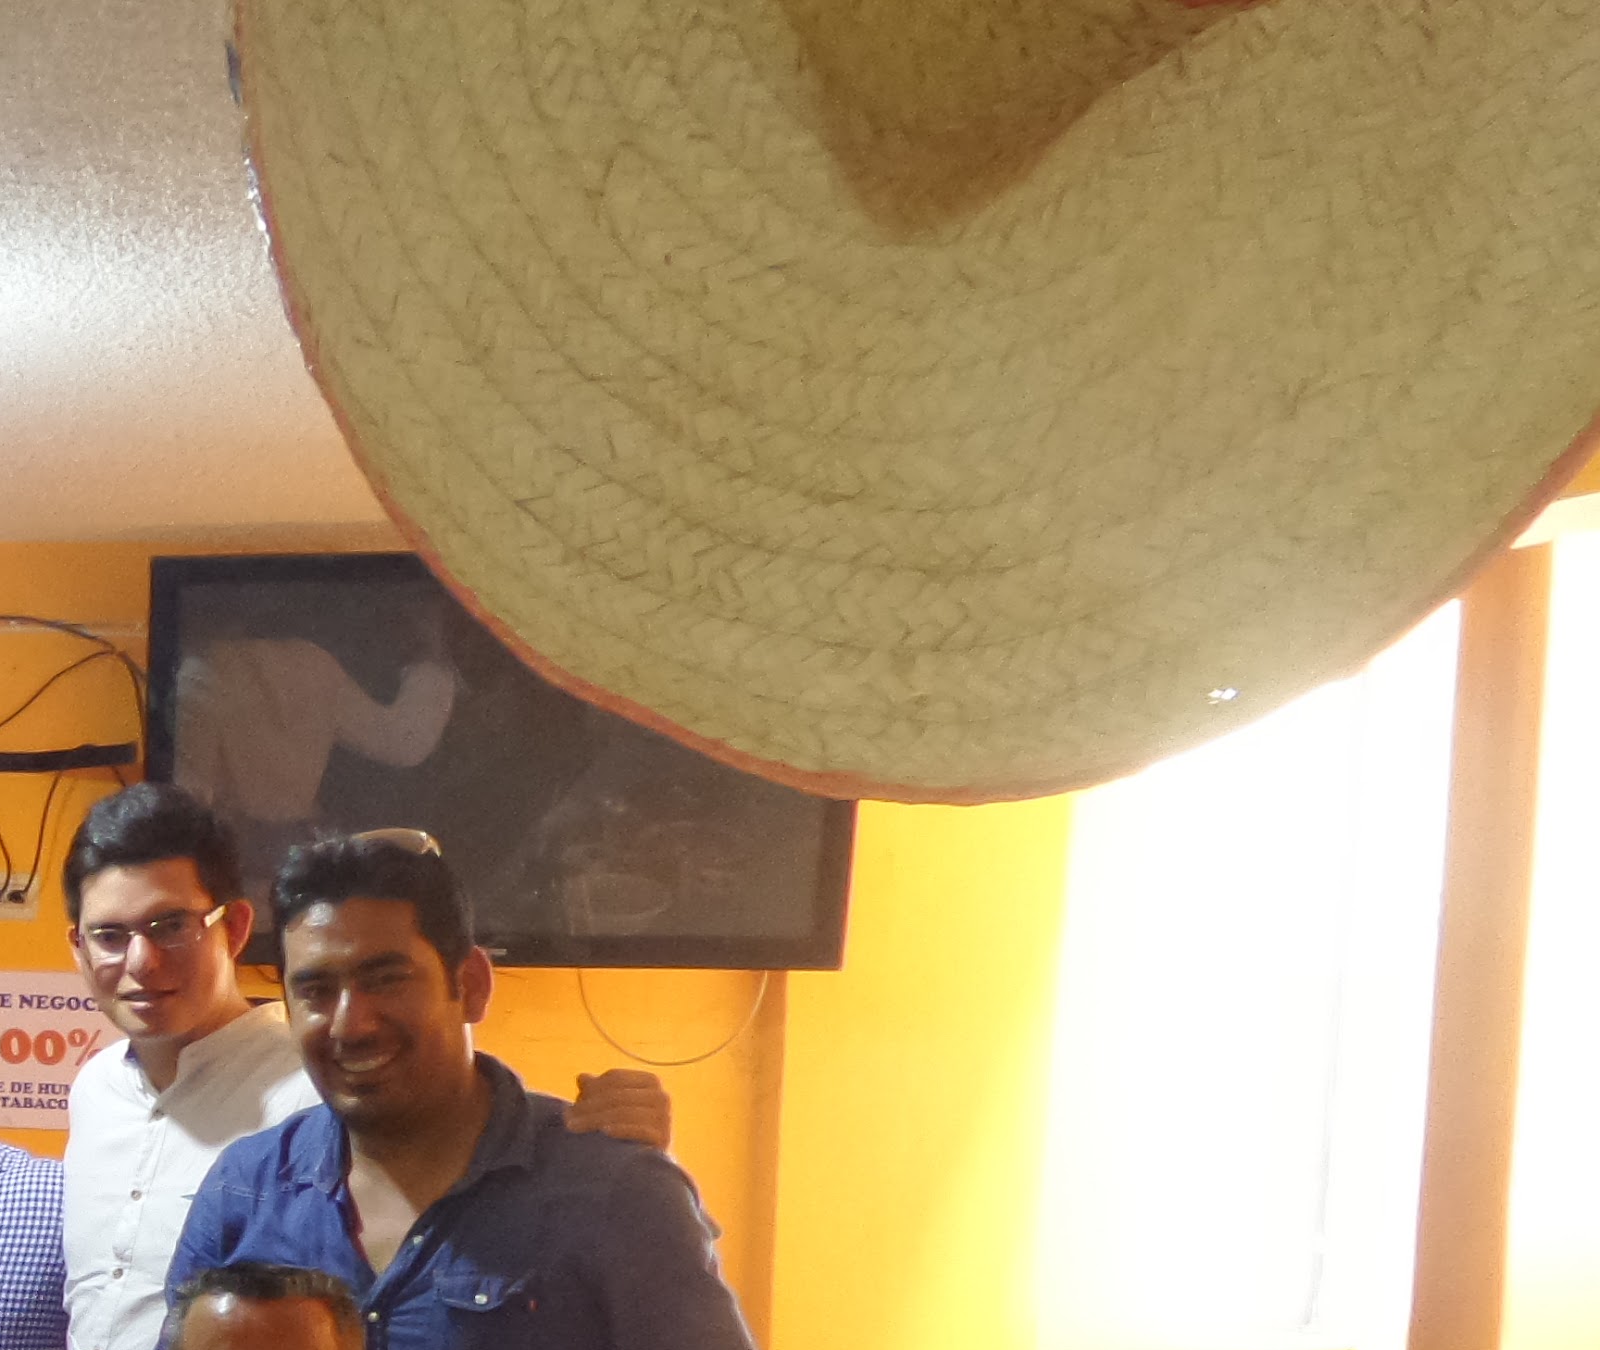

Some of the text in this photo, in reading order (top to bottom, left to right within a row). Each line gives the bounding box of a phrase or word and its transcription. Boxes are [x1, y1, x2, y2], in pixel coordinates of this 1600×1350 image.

[19, 995, 101, 1011] NEGOC
[10, 1082, 33, 1095] DE
[0, 1097, 69, 1110] TABACO
